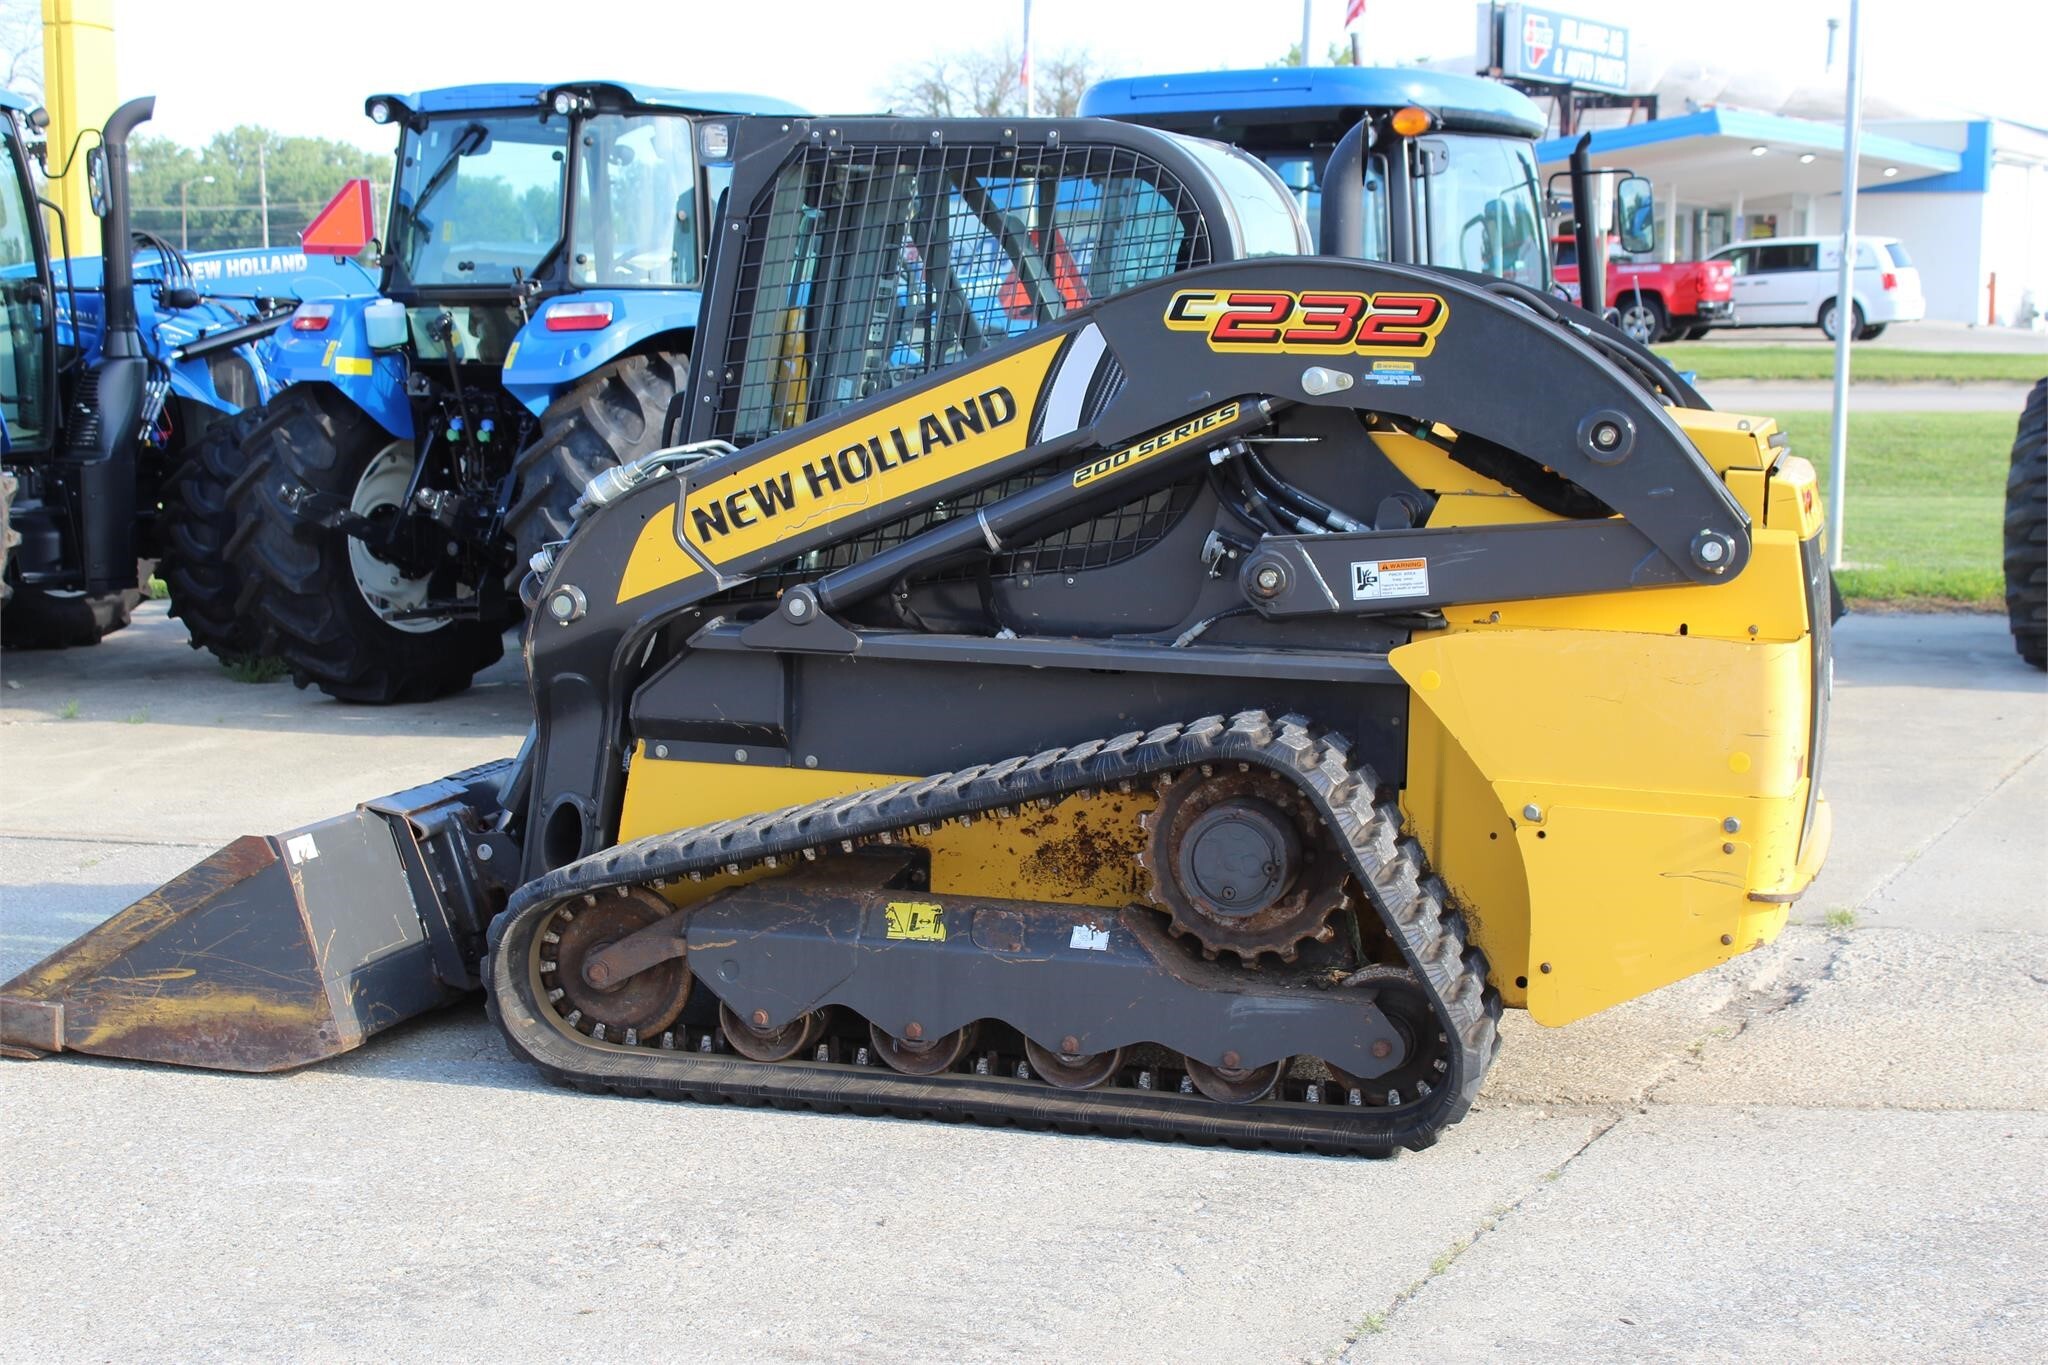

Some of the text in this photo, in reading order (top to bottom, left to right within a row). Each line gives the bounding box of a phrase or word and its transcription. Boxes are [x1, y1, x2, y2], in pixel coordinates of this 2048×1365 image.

[226, 254, 307, 278] HOLLAND
[1168, 293, 1442, 348] C232
[690, 385, 1019, 544] NEW HOLLAND
[1075, 404, 1237, 484] 200 SERIES
